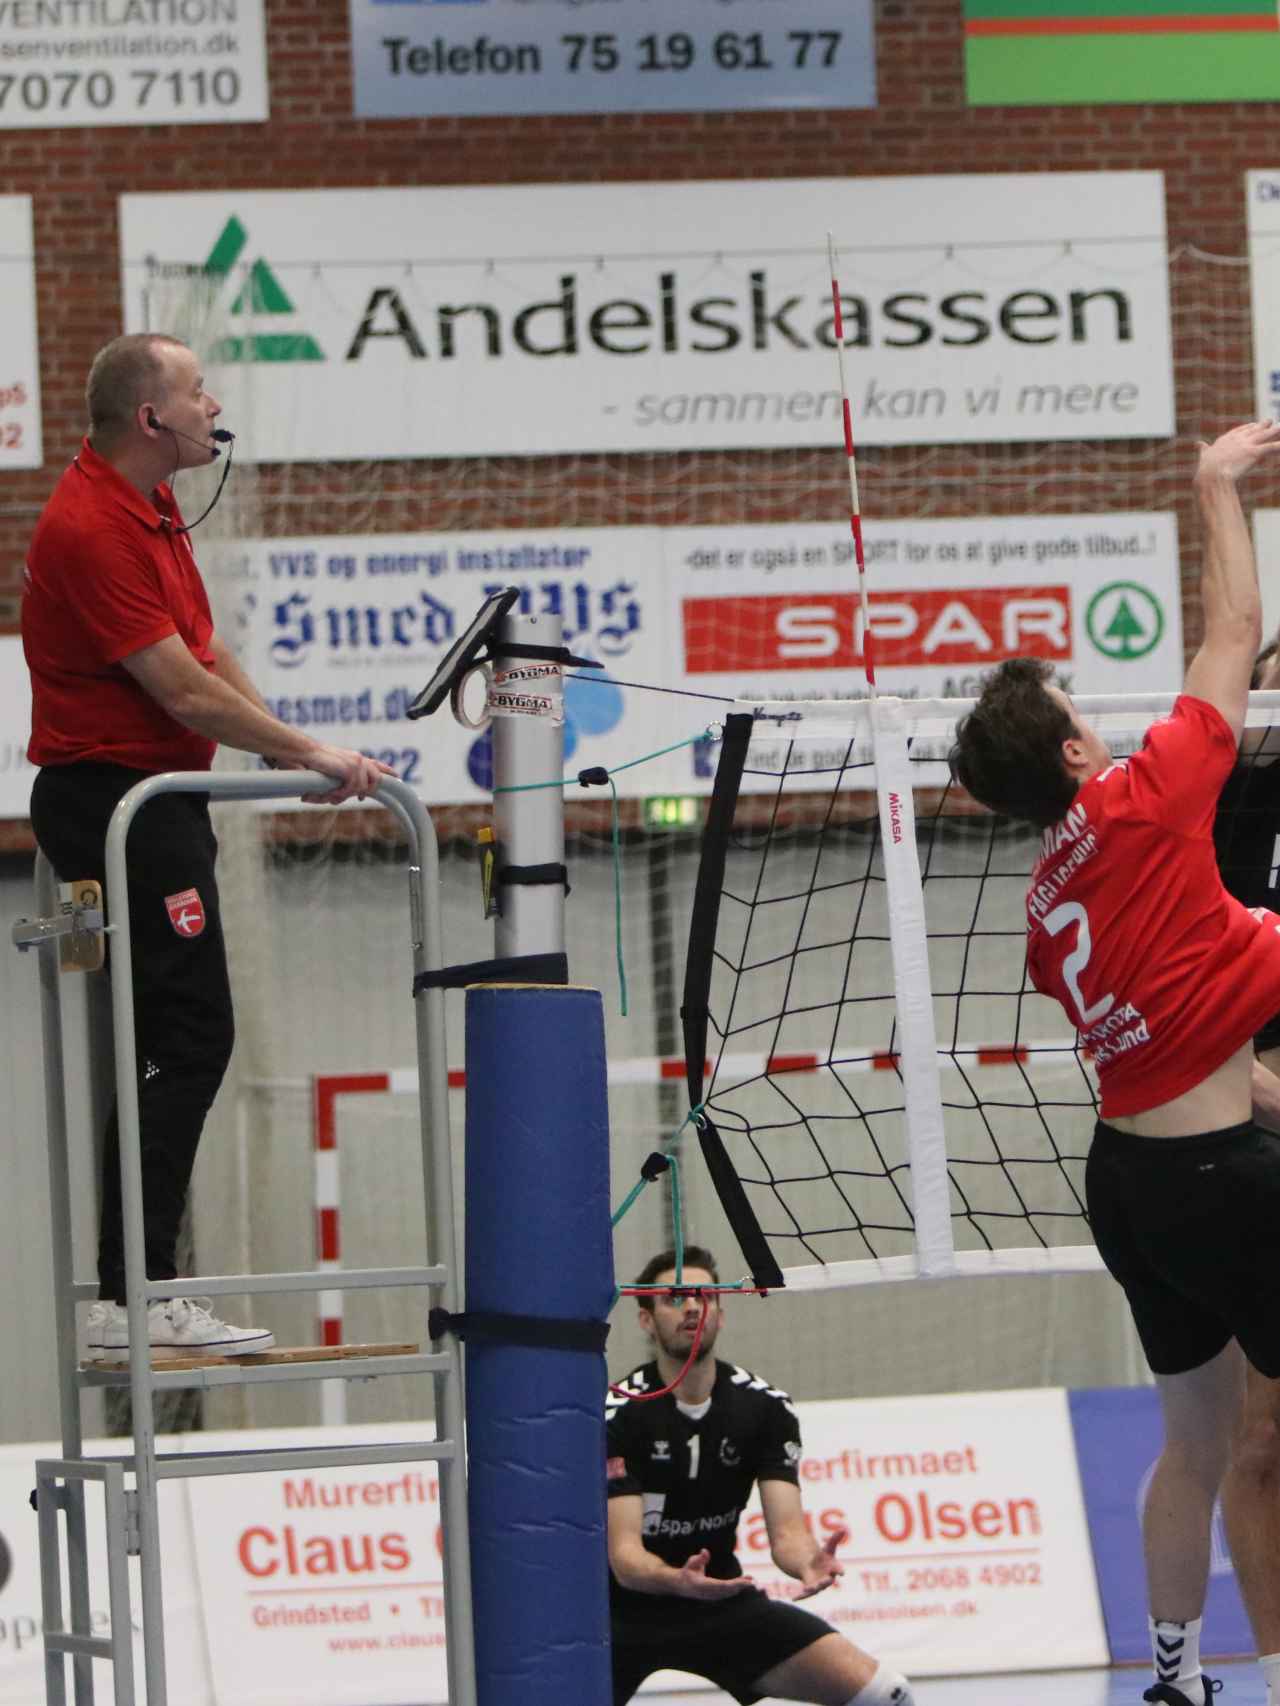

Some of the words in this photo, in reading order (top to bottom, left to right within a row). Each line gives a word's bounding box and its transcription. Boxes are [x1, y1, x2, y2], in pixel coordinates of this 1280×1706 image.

[382, 37, 542, 75] Telefon
[561, 34, 621, 73] 75
[637, 32, 696, 72] 19
[712, 31, 772, 71] 61
[786, 31, 843, 69] 77
[0, 70, 116, 110] 7070
[130, 67, 240, 107] 7110
[346, 271, 1134, 361] Andelskassen
[633, 387, 843, 426] sammen
[861, 377, 946, 419] kan
[965, 380, 1002, 416] vi
[1017, 379, 1140, 415] mere
[270, 552, 318, 577] VVS
[327, 556, 356, 579] og
[726, 548, 744, 568] er
[803, 547, 824, 568] en
[936, 541, 958, 562] os
[990, 537, 1027, 567] give
[1033, 535, 1080, 564] gode
[270, 589, 457, 669] Smed
[775, 597, 1070, 659] SPAR
[497, 695, 548, 709] BYGMA
[1042, 901, 1115, 1024] 2
[686, 1433, 700, 1479] 1
[873, 1491, 1043, 1544] Olsen
[237, 1525, 412, 1578] Claus
[906, 1567, 970, 1592] 2068
[252, 1600, 371, 1628] Grindsted
